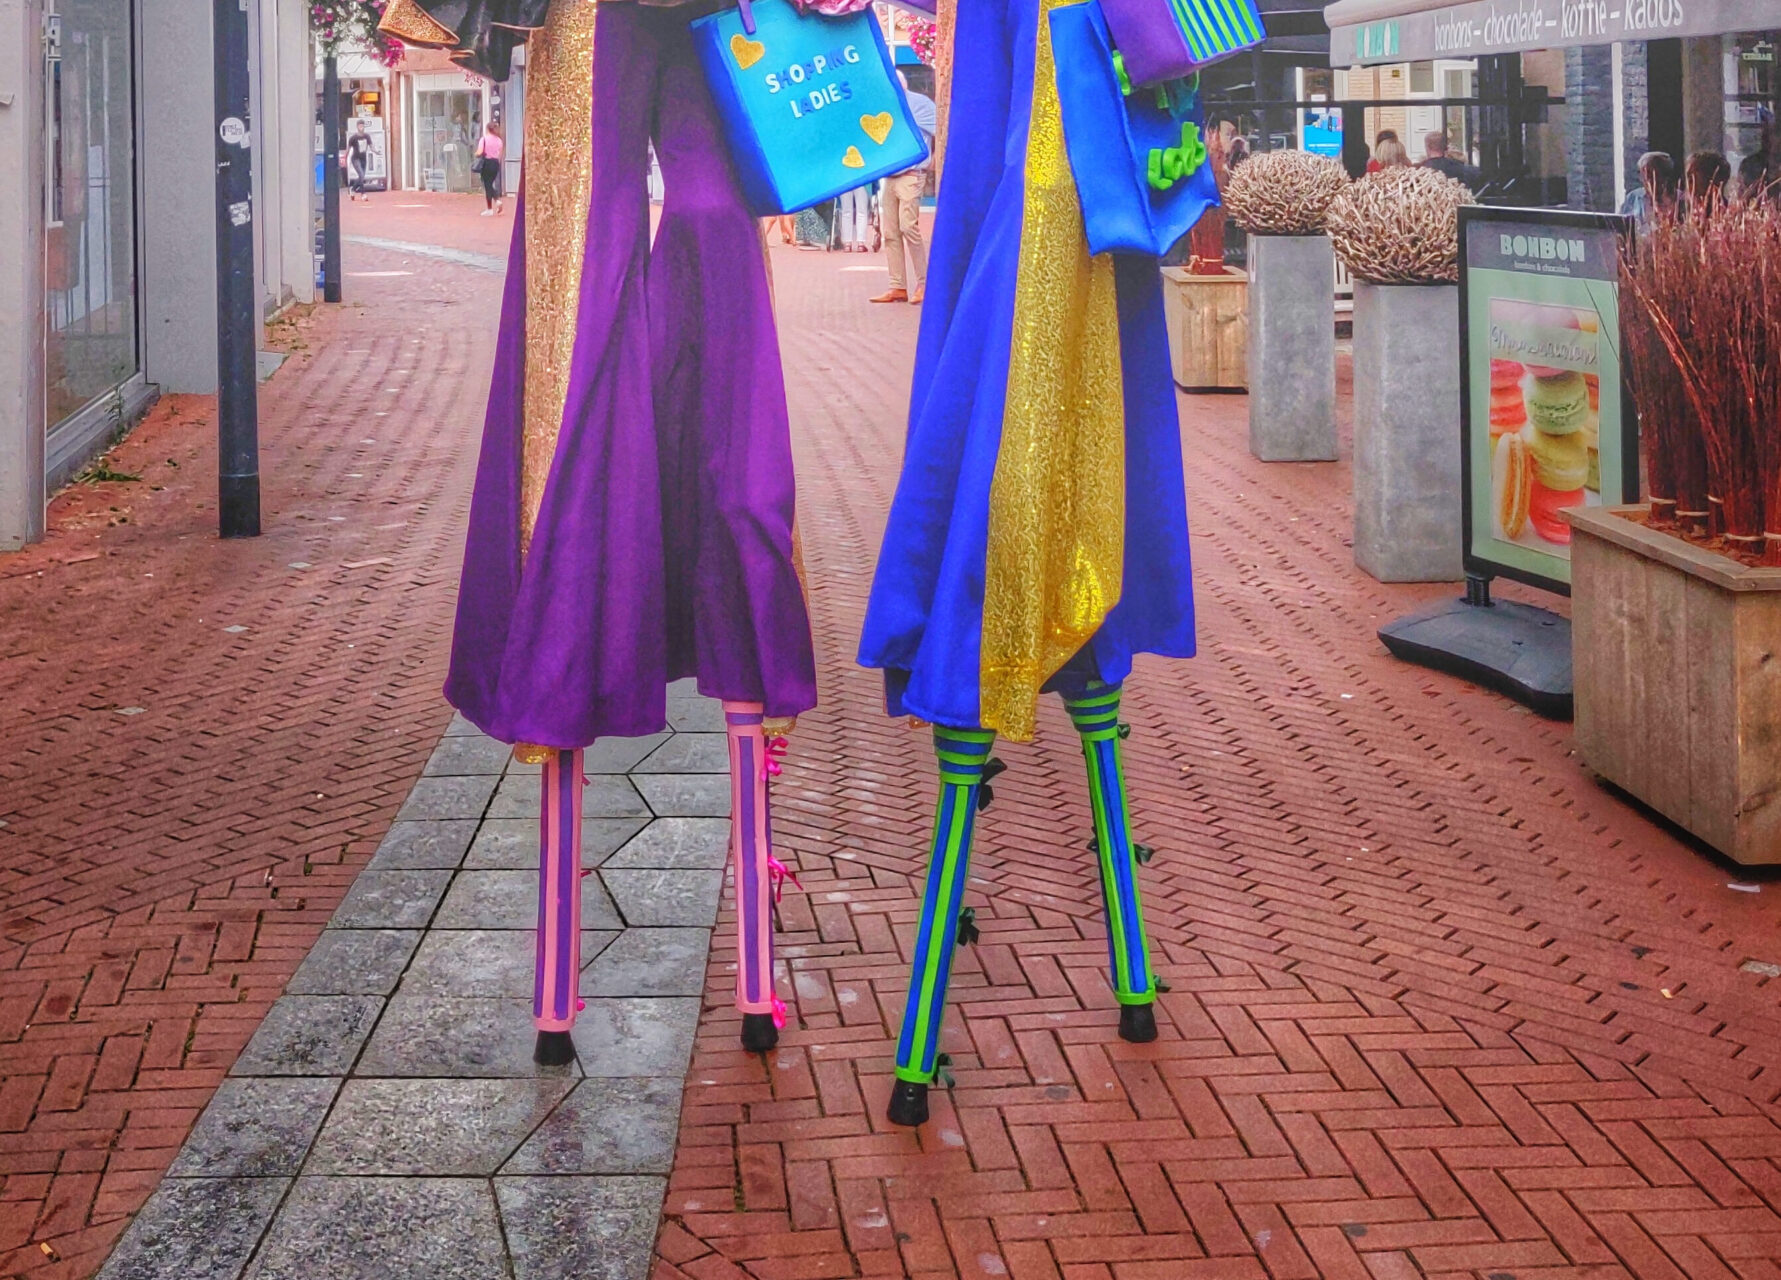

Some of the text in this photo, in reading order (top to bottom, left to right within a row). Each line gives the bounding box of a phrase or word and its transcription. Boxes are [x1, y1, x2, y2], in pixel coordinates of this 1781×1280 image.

[1434, 11, 1473, 52] bonbons
[765, 45, 860, 94] SHOPPING
[790, 81, 853, 118] LADIES
[1500, 234, 1585, 262] BONBON
